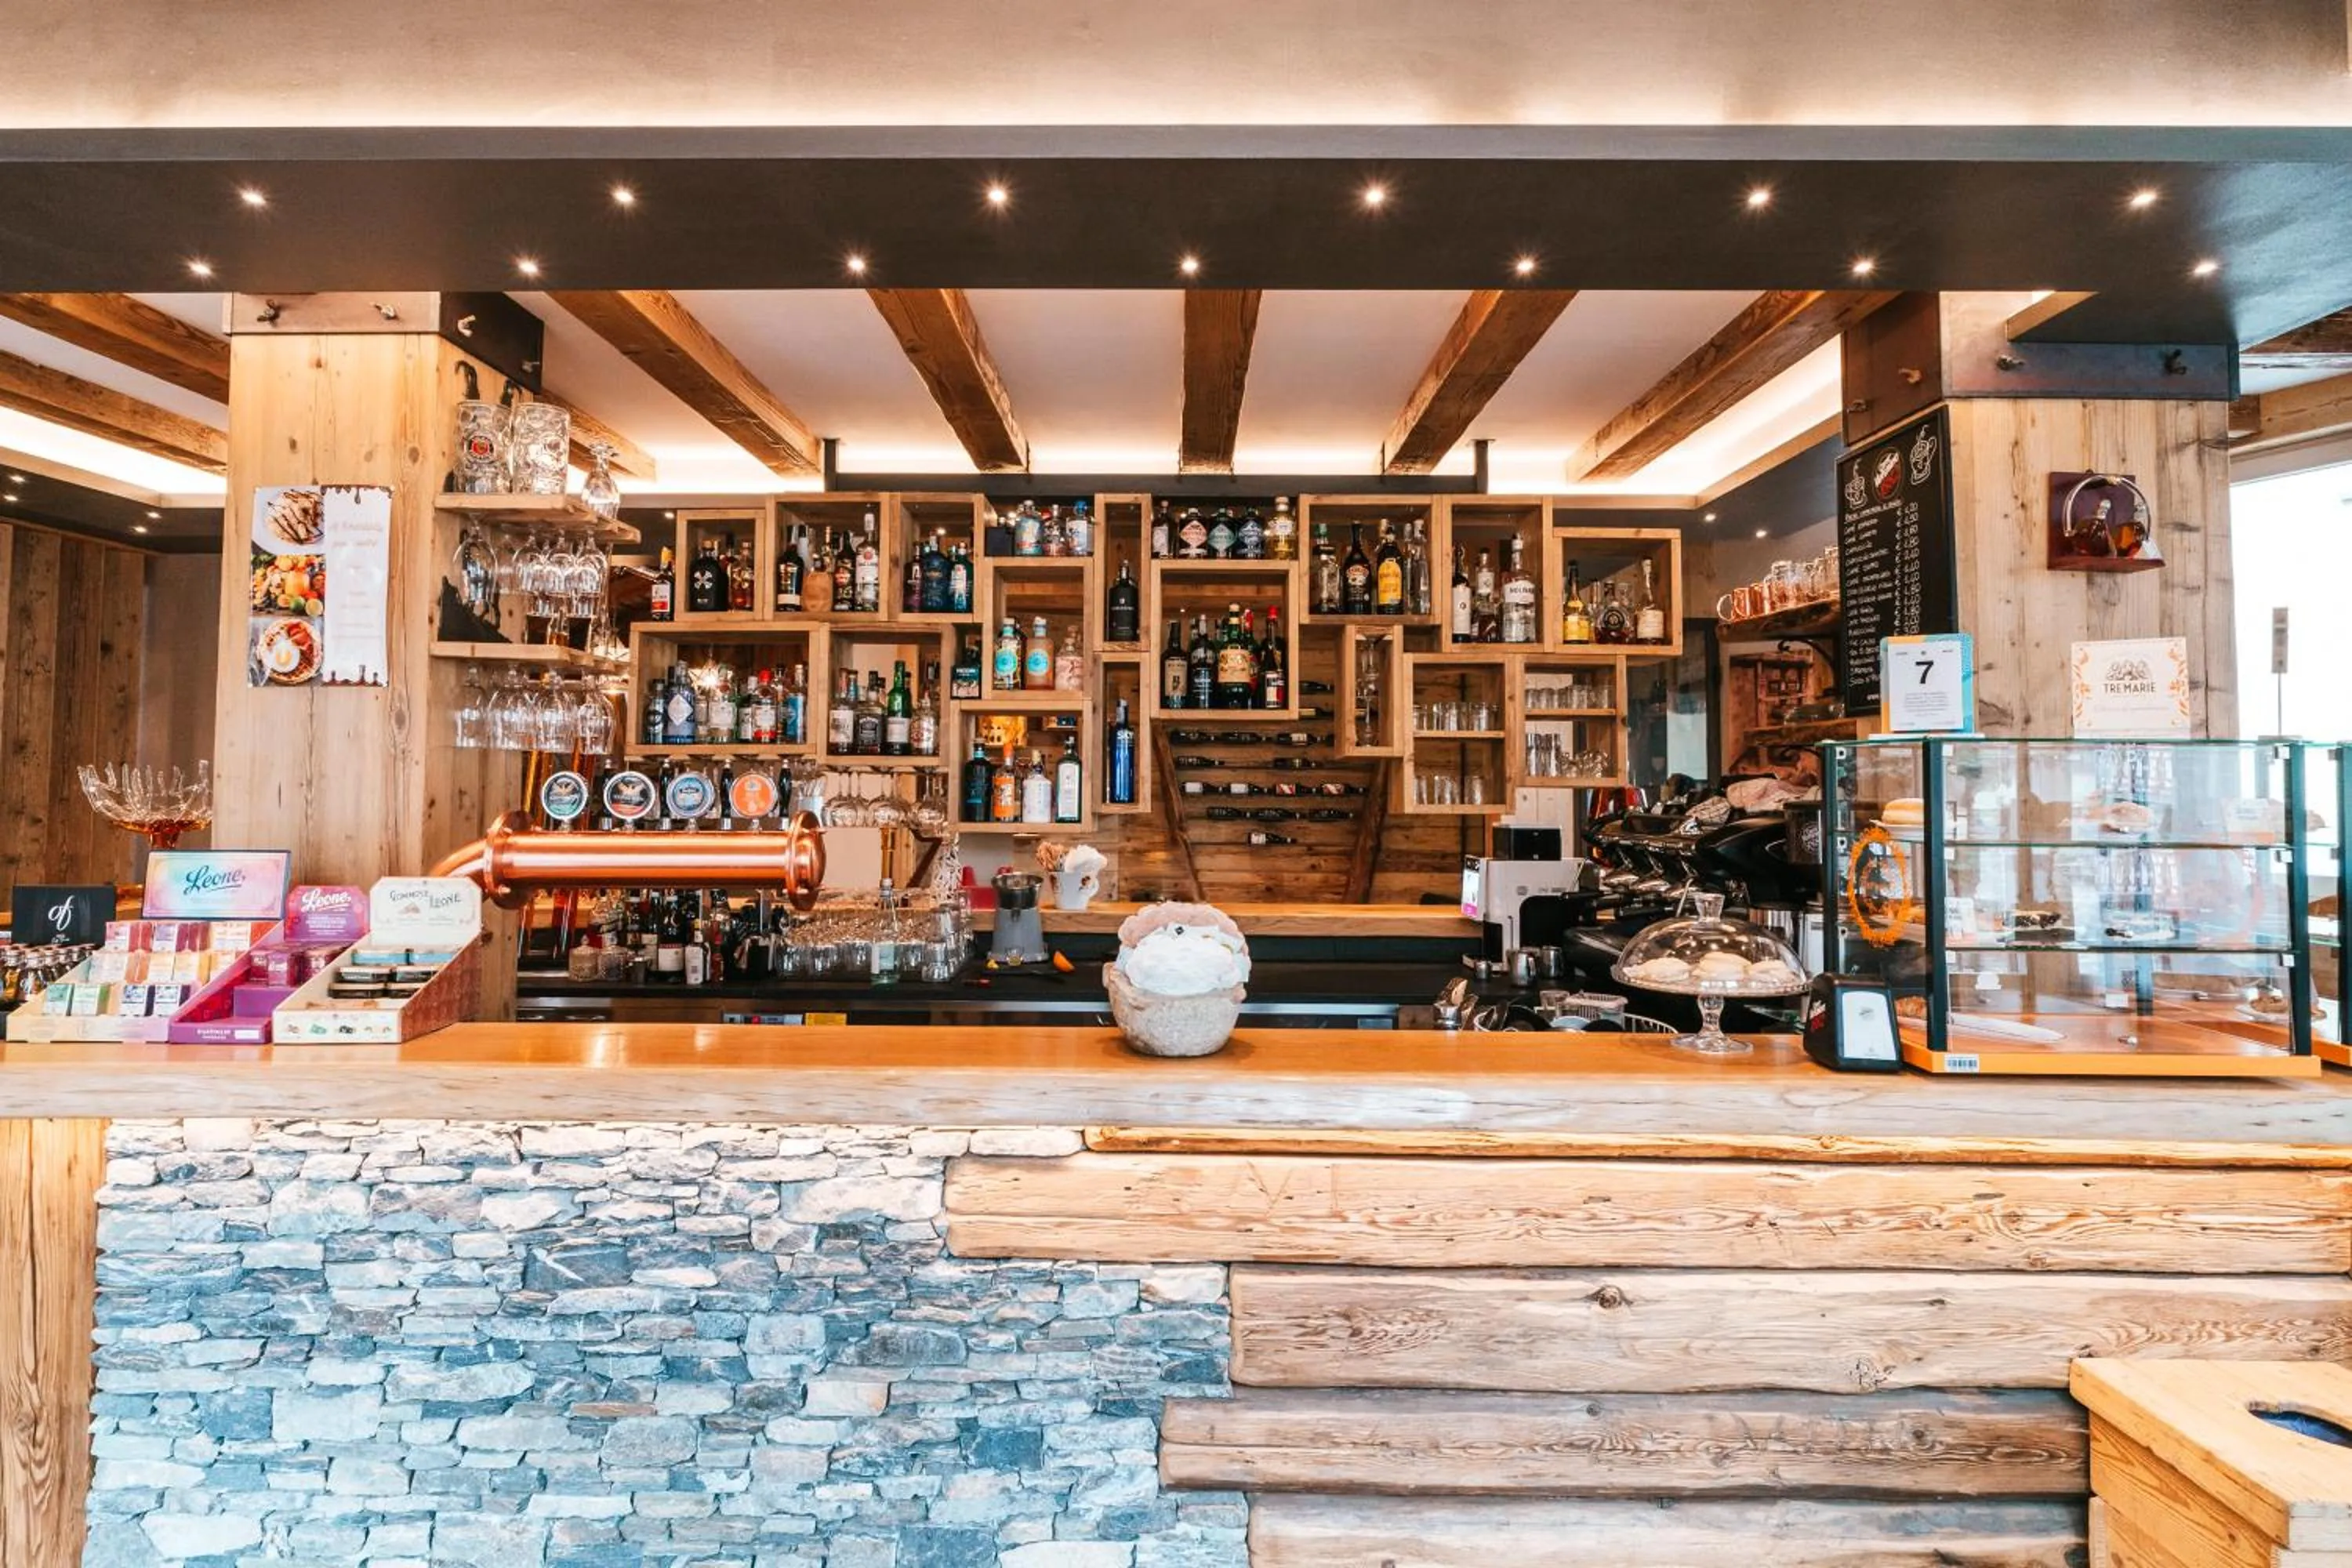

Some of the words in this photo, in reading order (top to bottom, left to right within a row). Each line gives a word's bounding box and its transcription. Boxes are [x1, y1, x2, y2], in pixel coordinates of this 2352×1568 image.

[1915, 660, 1933, 684] 7
[2103, 683, 2121, 694] TRE
[2123, 681, 2157, 694] MARIE
